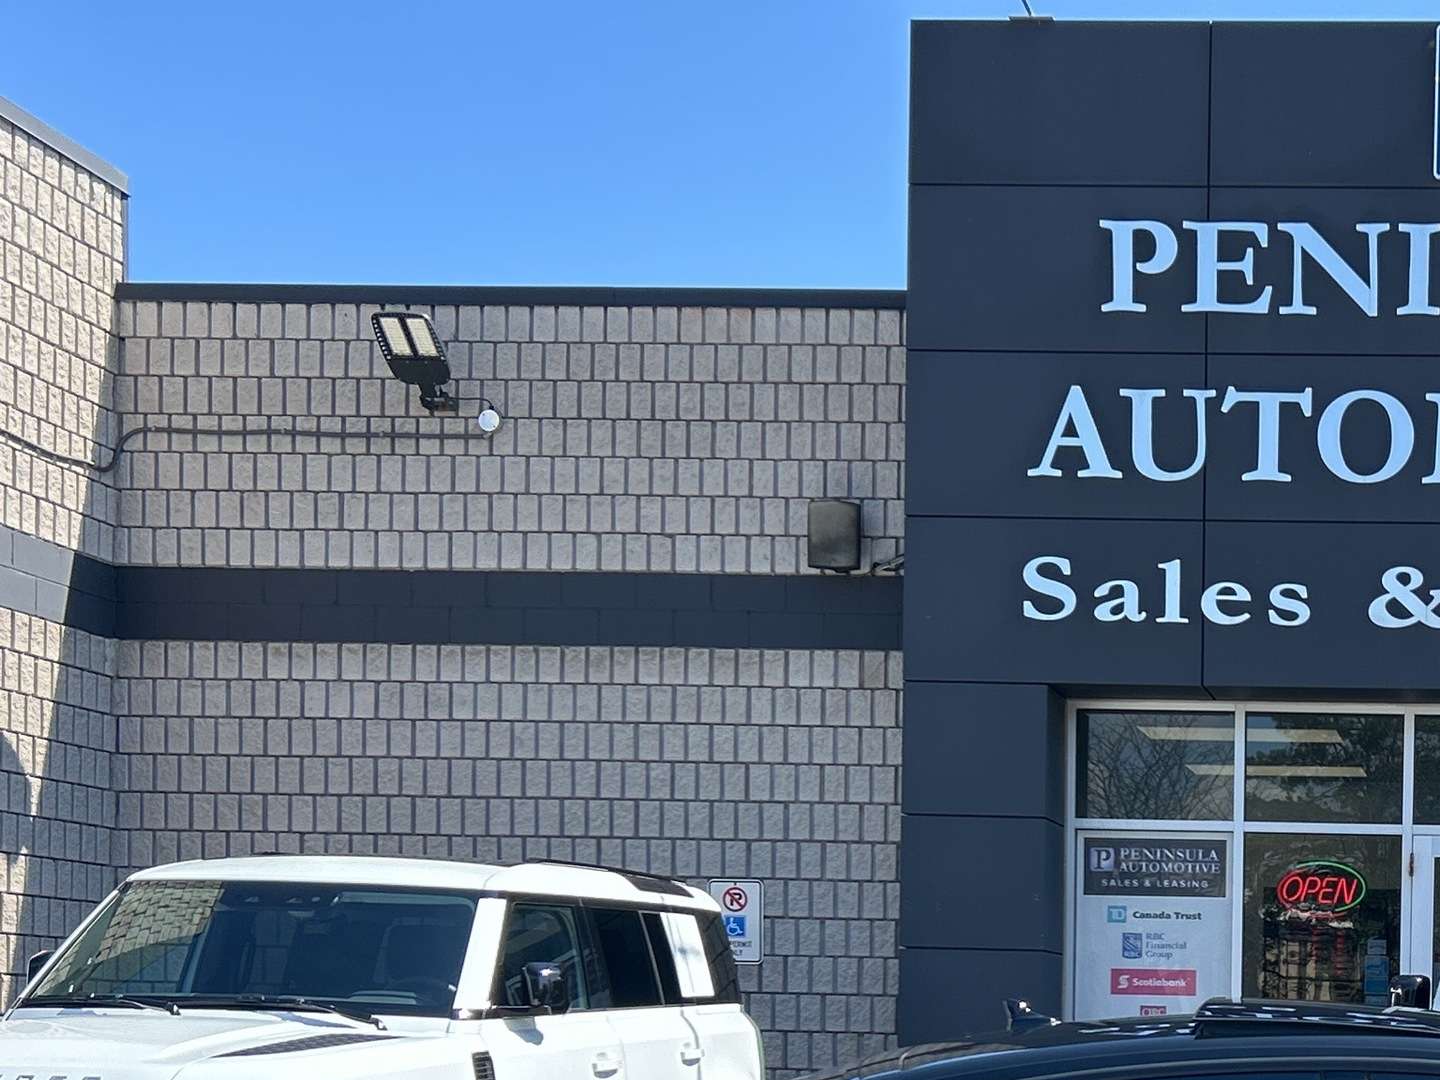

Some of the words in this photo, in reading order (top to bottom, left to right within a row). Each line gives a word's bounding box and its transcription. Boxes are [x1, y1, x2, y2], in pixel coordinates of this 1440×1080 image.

[1021, 557, 1310, 626] Sales
[1094, 849, 1112, 869] P
[1119, 848, 1220, 861] PENINSULA
[1119, 861, 1220, 874] AUTOMOTIVE
[1101, 879, 1139, 888] SALES
[1157, 879, 1209, 888] LEASING
[1281, 876, 1359, 905] OPEN
[1132, 911, 1171, 920] Canada
[1174, 912, 1202, 920] Trust
[1145, 942, 1187, 950] Financial
[1145, 951, 1173, 960] Group
[1132, 978, 1186, 987] Scotiabank
